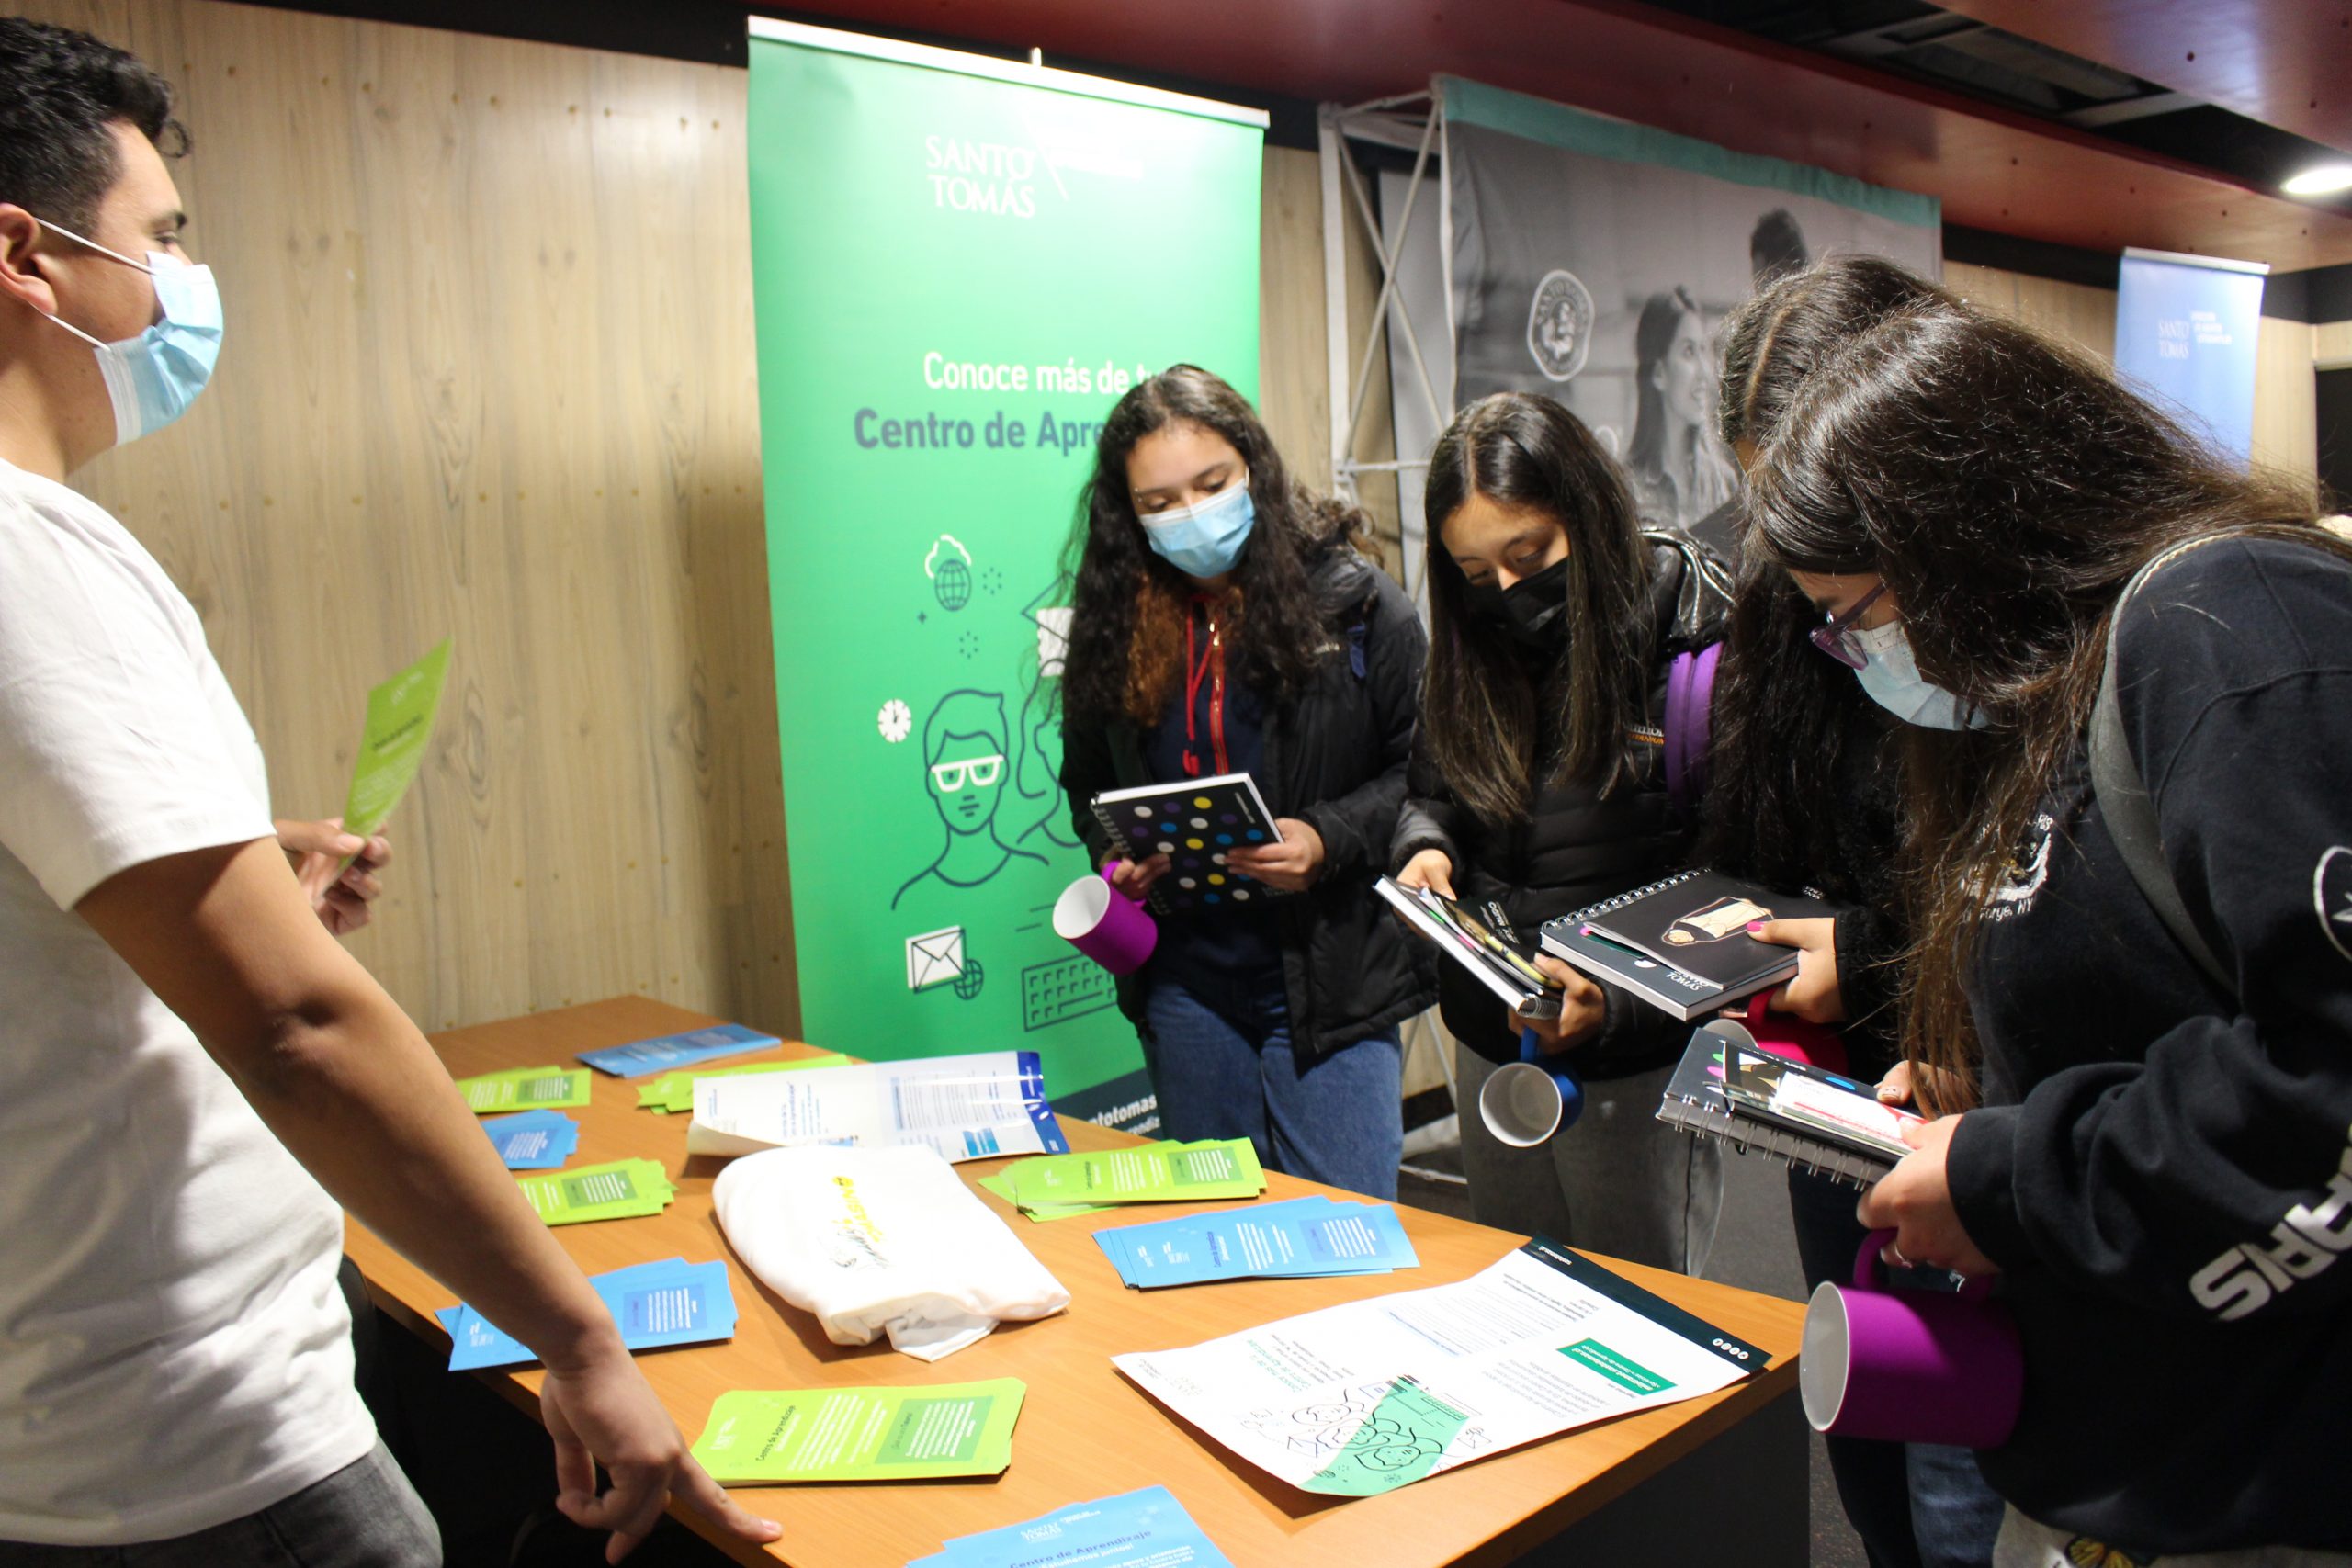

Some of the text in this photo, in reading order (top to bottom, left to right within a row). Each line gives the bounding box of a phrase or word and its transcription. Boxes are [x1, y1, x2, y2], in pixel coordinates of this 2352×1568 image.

[925, 134, 1035, 181] SANTO
[926, 174, 1036, 219] TOMÁS
[923, 351, 1029, 391] Conoce
[1036, 356, 1091, 394] más
[1097, 360, 1130, 395] de
[854, 408, 975, 450] Centro
[984, 411, 1026, 449] de
[2018, 898, 2034, 915] NY
[2189, 1148, 2352, 1322] ARIS
[1057, 1551, 1072, 1559] de
[1076, 1530, 1151, 1554] Aprendizaje
